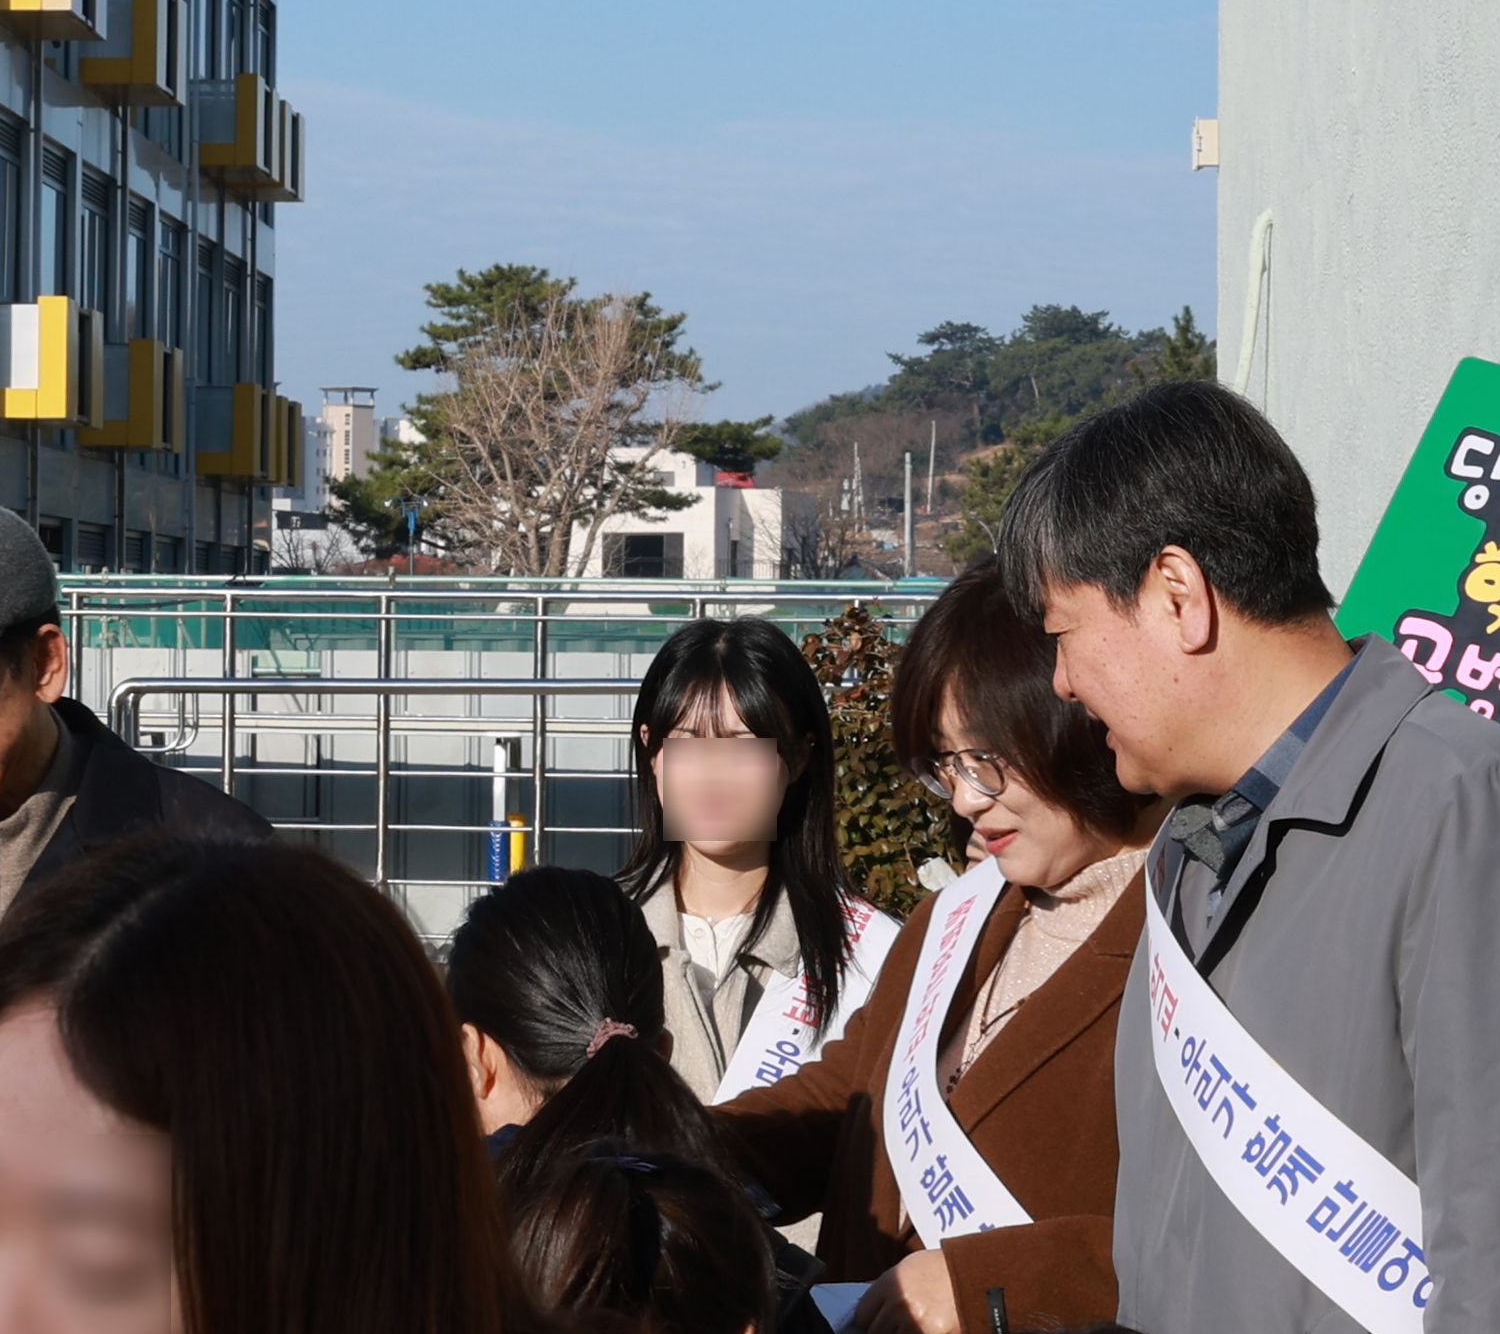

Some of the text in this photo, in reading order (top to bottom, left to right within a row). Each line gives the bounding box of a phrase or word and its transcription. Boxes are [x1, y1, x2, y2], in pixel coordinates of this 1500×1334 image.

[1181, 1034, 1258, 1140] 우리가
[1241, 1114, 1326, 1206] 함께
[920, 1154, 975, 1233] 함께
